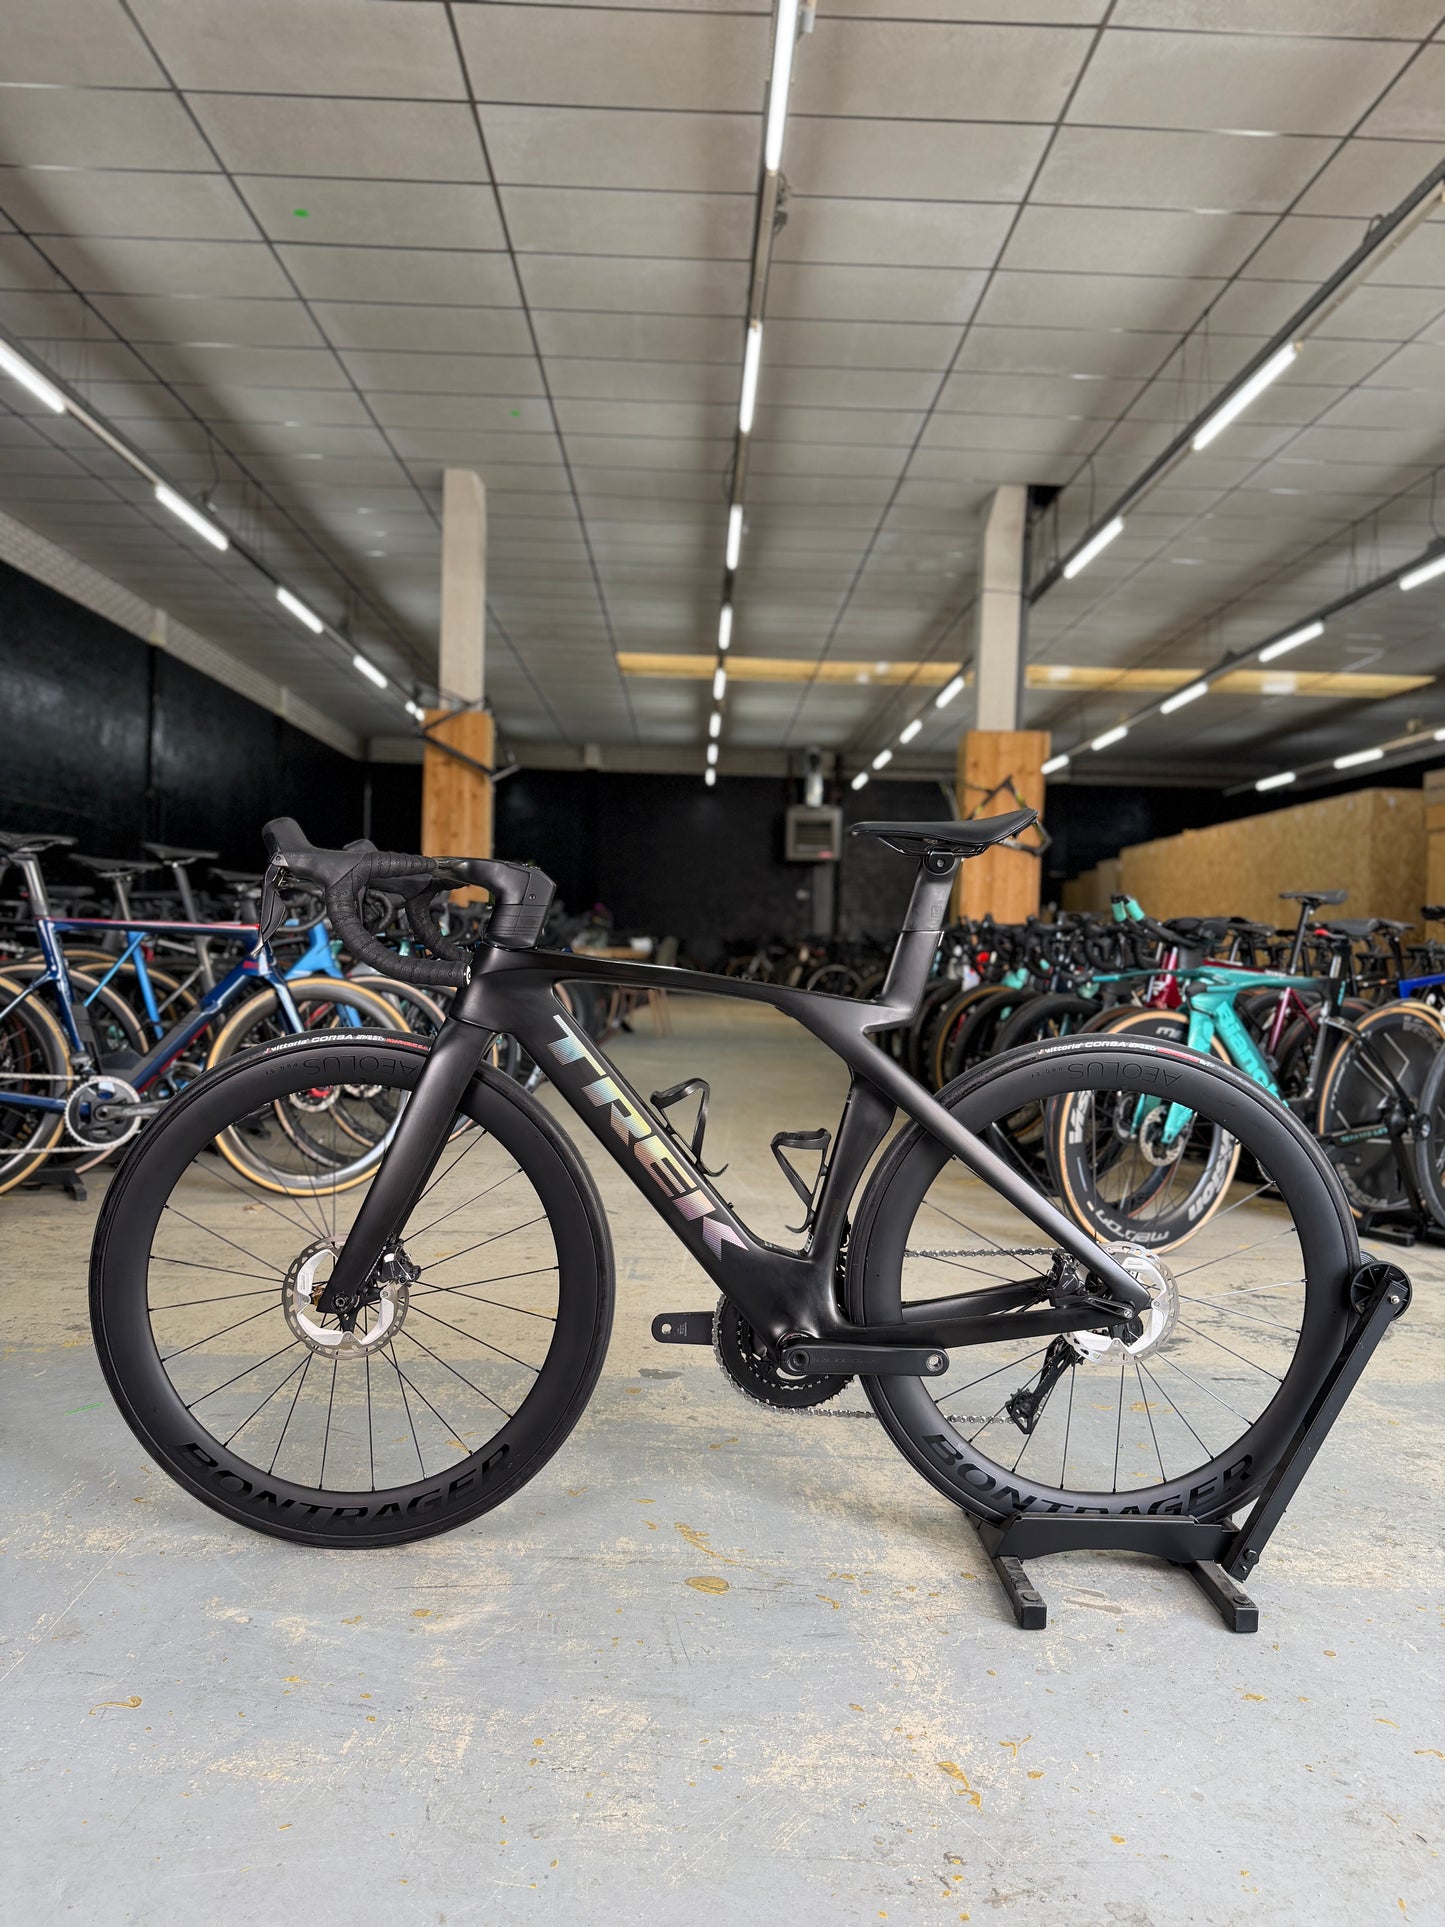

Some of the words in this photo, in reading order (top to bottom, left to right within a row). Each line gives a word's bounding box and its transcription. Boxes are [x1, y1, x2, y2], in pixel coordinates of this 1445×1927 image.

[270, 1039, 308, 1052] vittoria
[311, 1034, 353, 1042] CORSA
[1045, 1043, 1081, 1053] vittoria
[1215, 1001, 1289, 1107] Bianch
[303, 1055, 420, 1076] AEOLUS
[1068, 1061, 1182, 1087] AEOLUS
[547, 1014, 749, 1262] TREK
[181, 1442, 511, 1528] BONTRAGER
